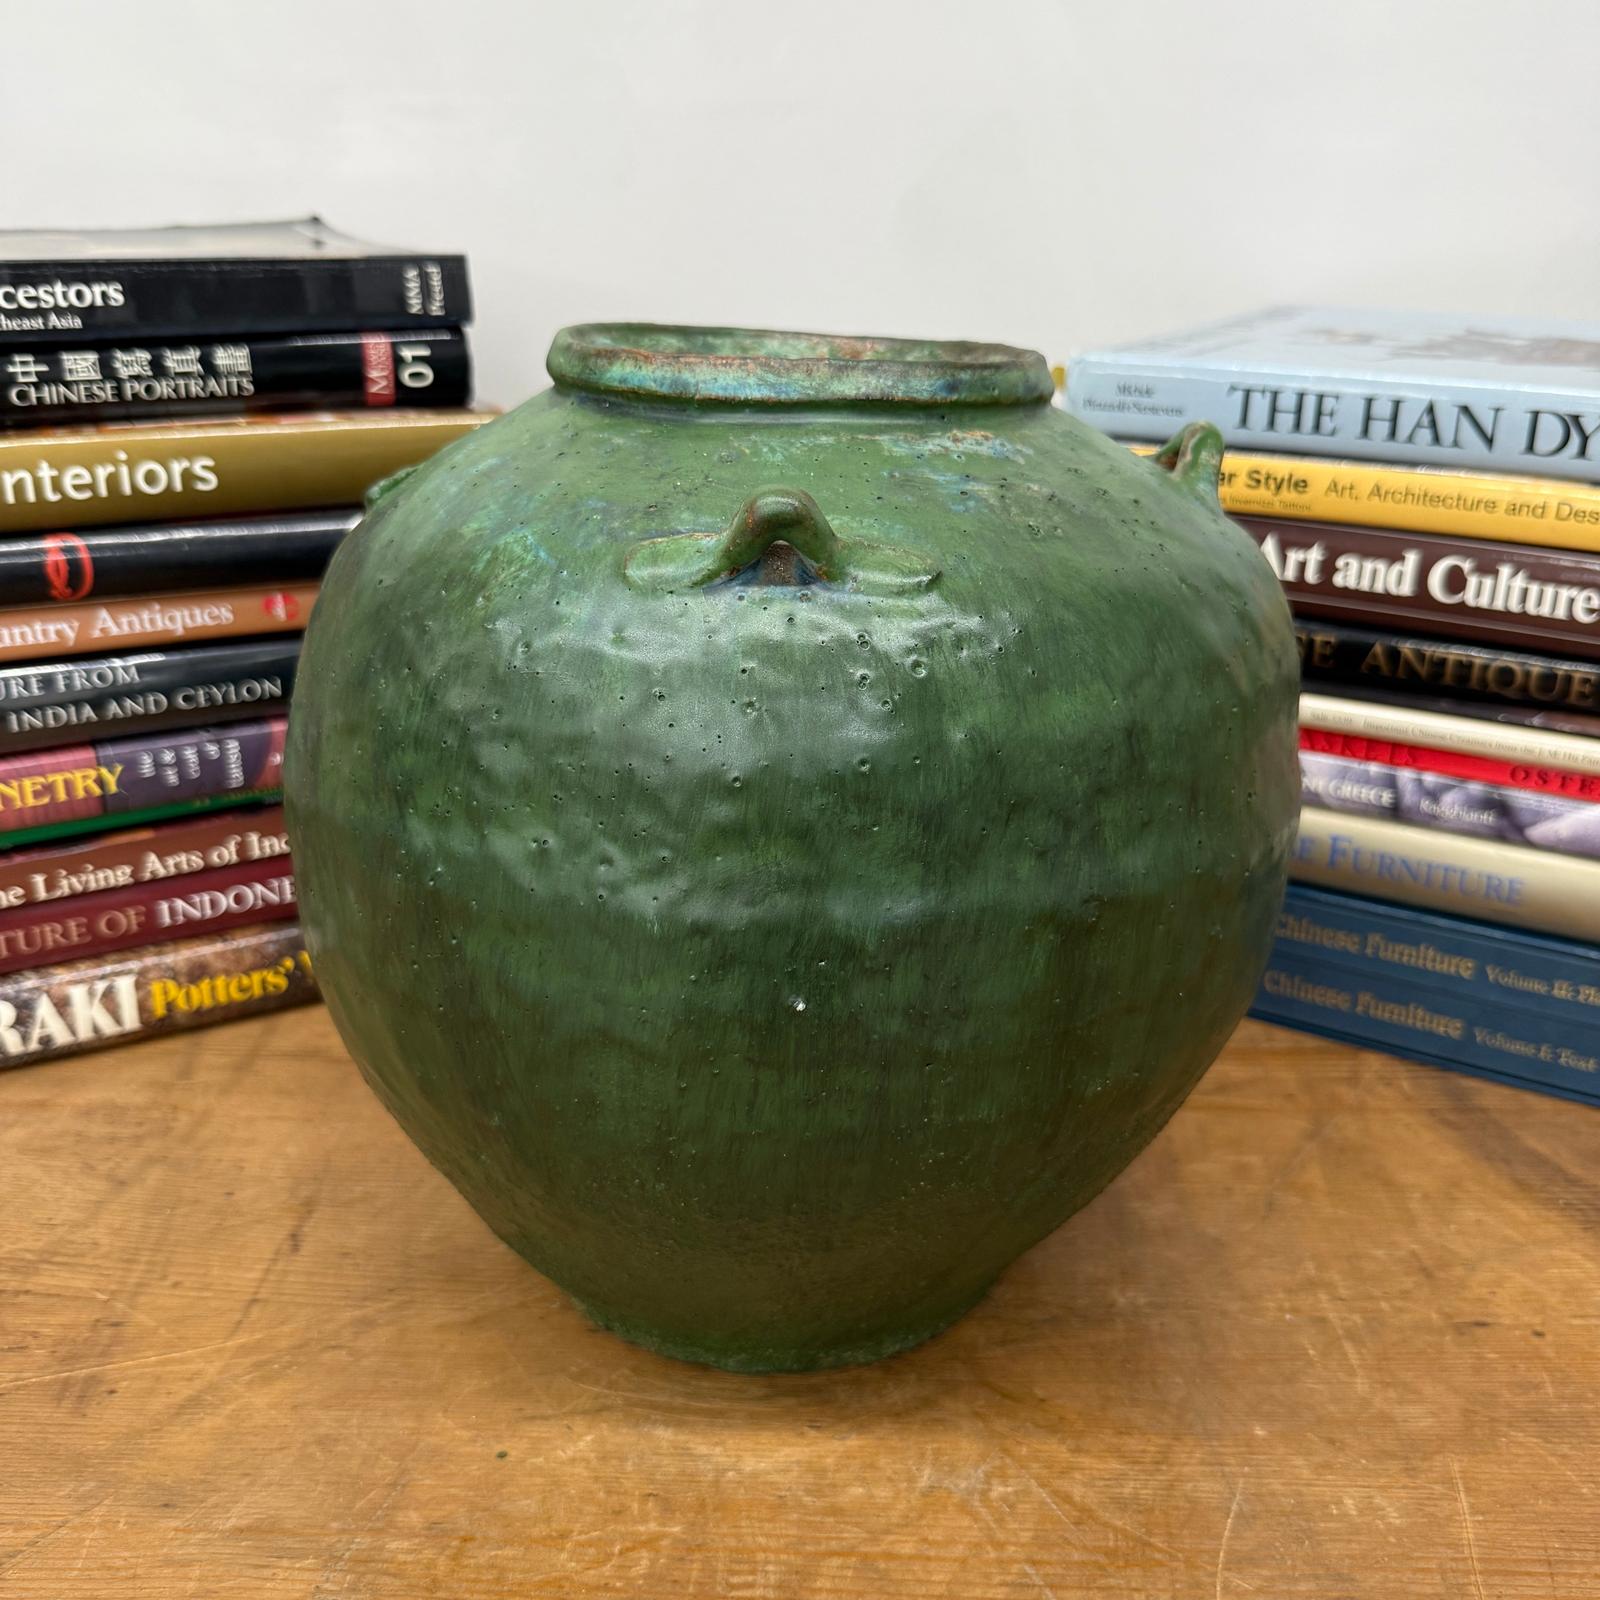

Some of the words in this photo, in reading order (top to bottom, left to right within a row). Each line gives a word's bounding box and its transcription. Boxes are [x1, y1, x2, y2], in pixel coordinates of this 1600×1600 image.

[0, 279, 125, 309] cestors
[47, 311, 83, 330] Asia
[398, 344, 435, 389] 01
[9, 382, 119, 407] CHINESE
[124, 374, 255, 401] PORTRAITS
[1228, 387, 1343, 438] THE
[1359, 396, 1502, 455] HAN
[1519, 410, 1600, 461] DY
[1, 450, 219, 505] nteriors
[1246, 469, 1309, 497] Style
[1366, 482, 1498, 515] Architecture
[1504, 500, 1547, 520] and
[1259, 530, 1326, 583] Art
[1331, 547, 1420, 597] and
[1426, 554, 1600, 624] Culture
[92, 602, 236, 640] Antiques
[56, 665, 142, 693] FROM
[7, 703, 99, 733] INDIA
[105, 693, 170, 721] AND
[178, 676, 283, 711] CEYLON
[30, 864, 135, 902] Living
[140, 847, 206, 883] Arts
[204, 833, 242, 867] of
[1327, 834, 1526, 905] FURNITURE
[98, 904, 147, 938] OF
[1365, 933, 1479, 980] Furniture
[1486, 964, 1549, 995] Volume
[0, 974, 142, 1056] RAKI
[1264, 970, 1352, 1012] Chinese
[1355, 991, 1467, 1038] Furniture
[1474, 1027, 1537, 1057] Volume
